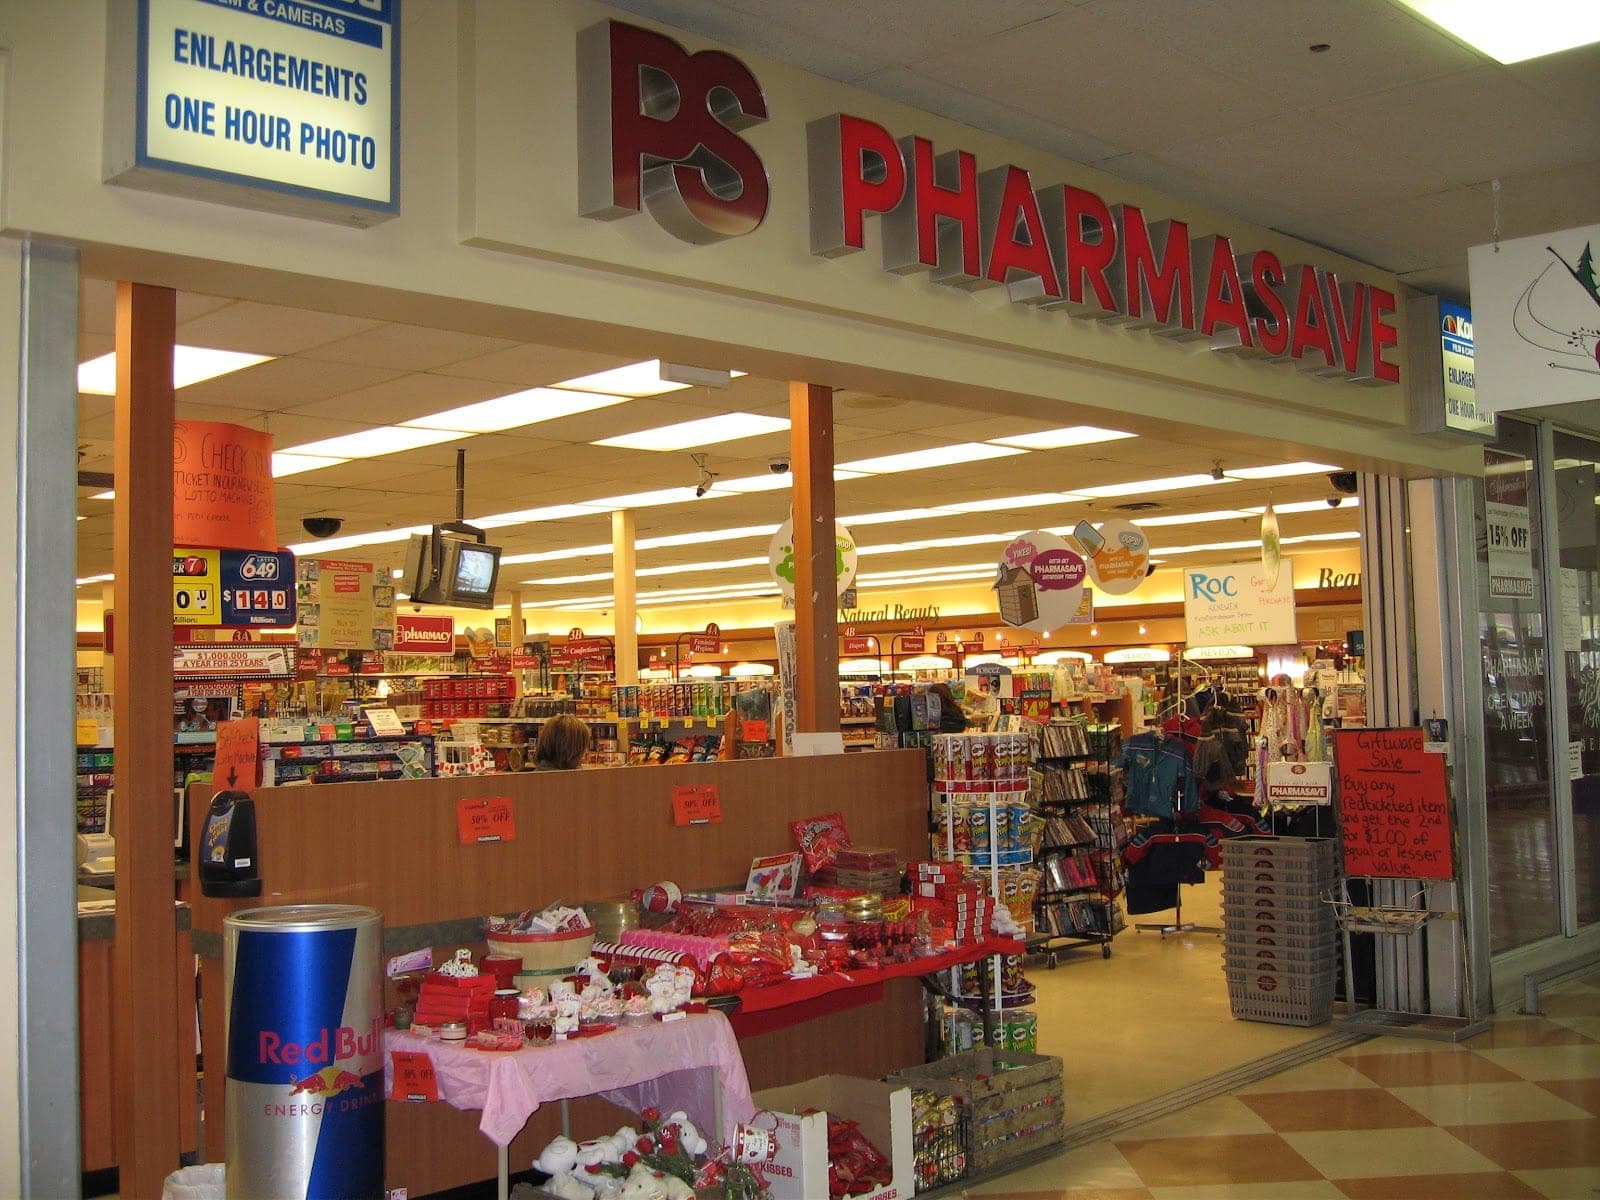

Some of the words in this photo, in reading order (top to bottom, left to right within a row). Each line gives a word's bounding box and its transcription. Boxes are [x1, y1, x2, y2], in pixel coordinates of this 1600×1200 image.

[263, 0, 346, 35] CAMERAS
[173, 28, 368, 106] ENLARGEMENTS
[164, 93, 216, 137] ONE
[225, 105, 292, 152] HOUR
[300, 122, 377, 171] PHOTO
[606, 20, 770, 238] PS
[838, 112, 1400, 384] PHARMASAVE
[1449, 398, 1459, 416] ONE
[1460, 401, 1476, 420] HOUR
[1489, 524, 1509, 547] 15%
[1511, 527, 1528, 549] OFF
[1034, 564, 1083, 574] PHARMASAVE
[1491, 578, 1533, 595] PHARMASAVE
[839, 604, 889, 625] Natural
[893, 603, 940, 624] Beauty
[844, 626, 856, 637] 4B
[1521, 691, 1544, 707] DAYS
[1500, 713, 1507, 731] A
[1509, 710, 1534, 730] WEEK
[1357, 732, 1422, 751] Giftware
[1370, 751, 1403, 769] Sale
[1271, 786, 1326, 797] PHARMASAVE
[1344, 776, 1367, 795] Buy
[1371, 781, 1395, 797] any
[1418, 798, 1445, 814] item
[493, 812, 510, 823] OFF
[1363, 816, 1384, 828] get
[1387, 814, 1410, 825] the
[1413, 831, 1429, 845] of
[1397, 847, 1441, 861] lesser
[259, 1028, 329, 1065] Red
[264, 1103, 333, 1117] ENERGY
